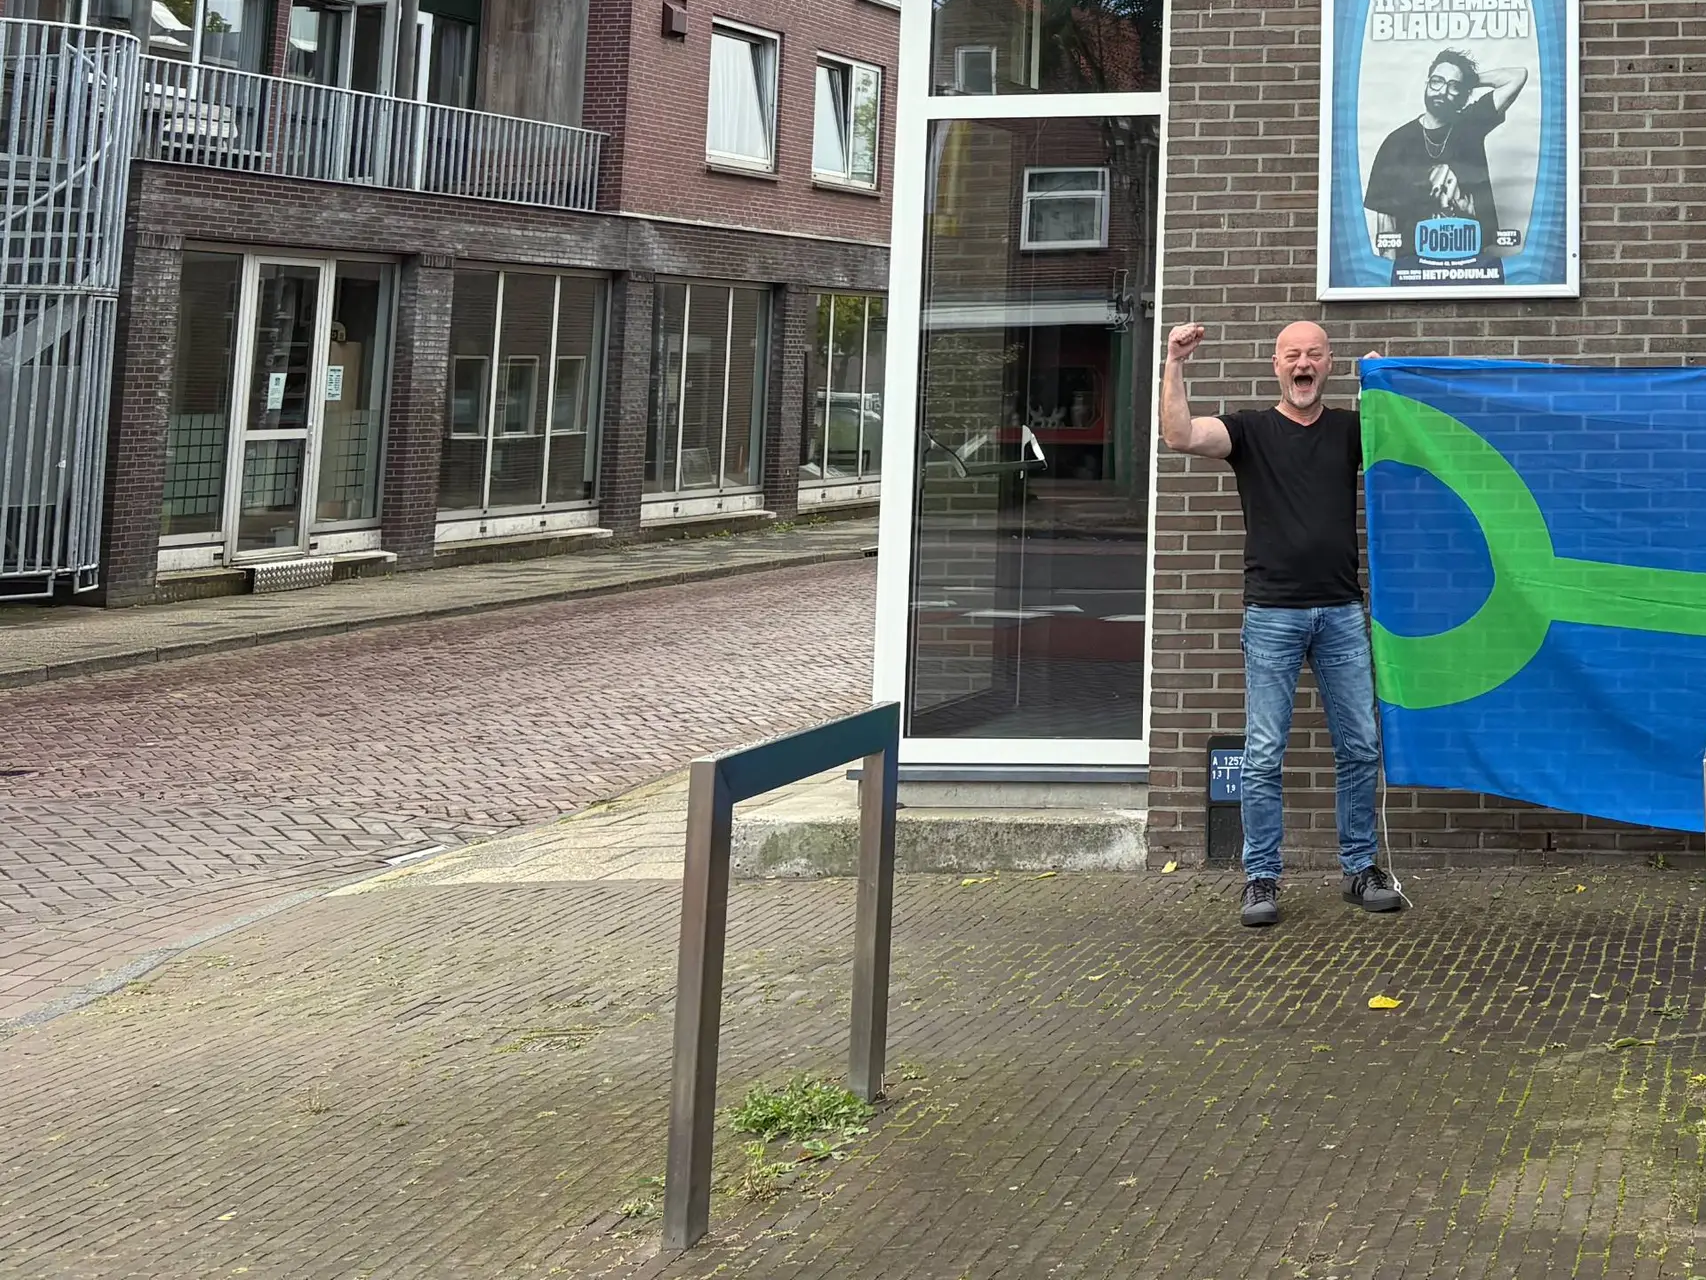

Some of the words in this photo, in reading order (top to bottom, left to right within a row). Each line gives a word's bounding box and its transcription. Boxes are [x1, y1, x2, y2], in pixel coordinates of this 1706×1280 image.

[1372, 10, 1529, 40] BLAUDZUN
[1377, 239, 1402, 248] 20:00
[1422, 268, 1500, 280] HETPODIUM.NL
[1213, 756, 1218, 766] A
[1224, 756, 1244, 766] 1257
